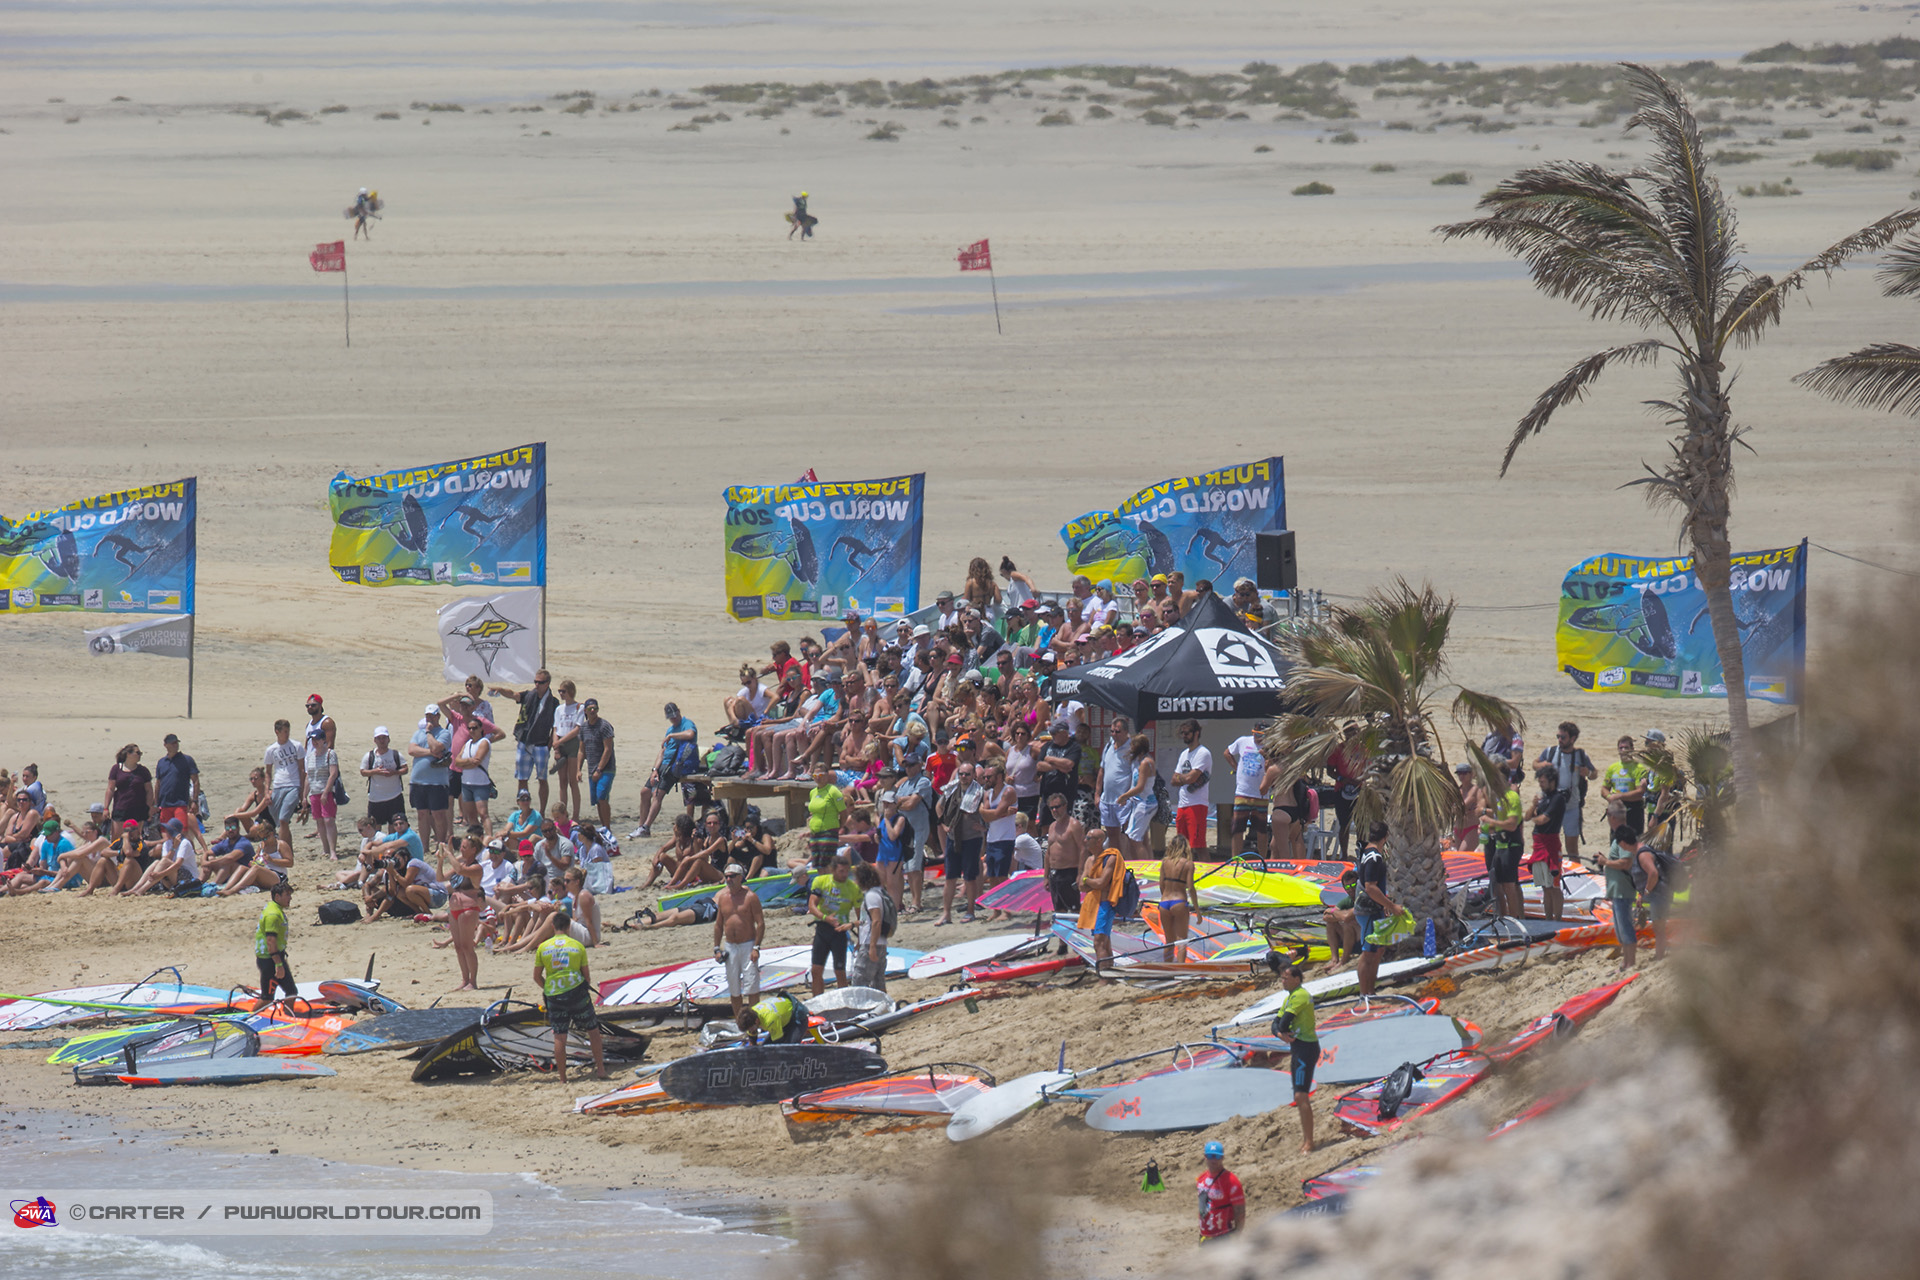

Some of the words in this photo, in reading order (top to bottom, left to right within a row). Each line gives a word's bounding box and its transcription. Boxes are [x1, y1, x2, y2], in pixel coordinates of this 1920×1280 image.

[467, 620, 509, 638] JP
[1217, 676, 1286, 688] MYSTIC
[1173, 696, 1234, 712] MYSTIC
[741, 1057, 828, 1088] patrik
